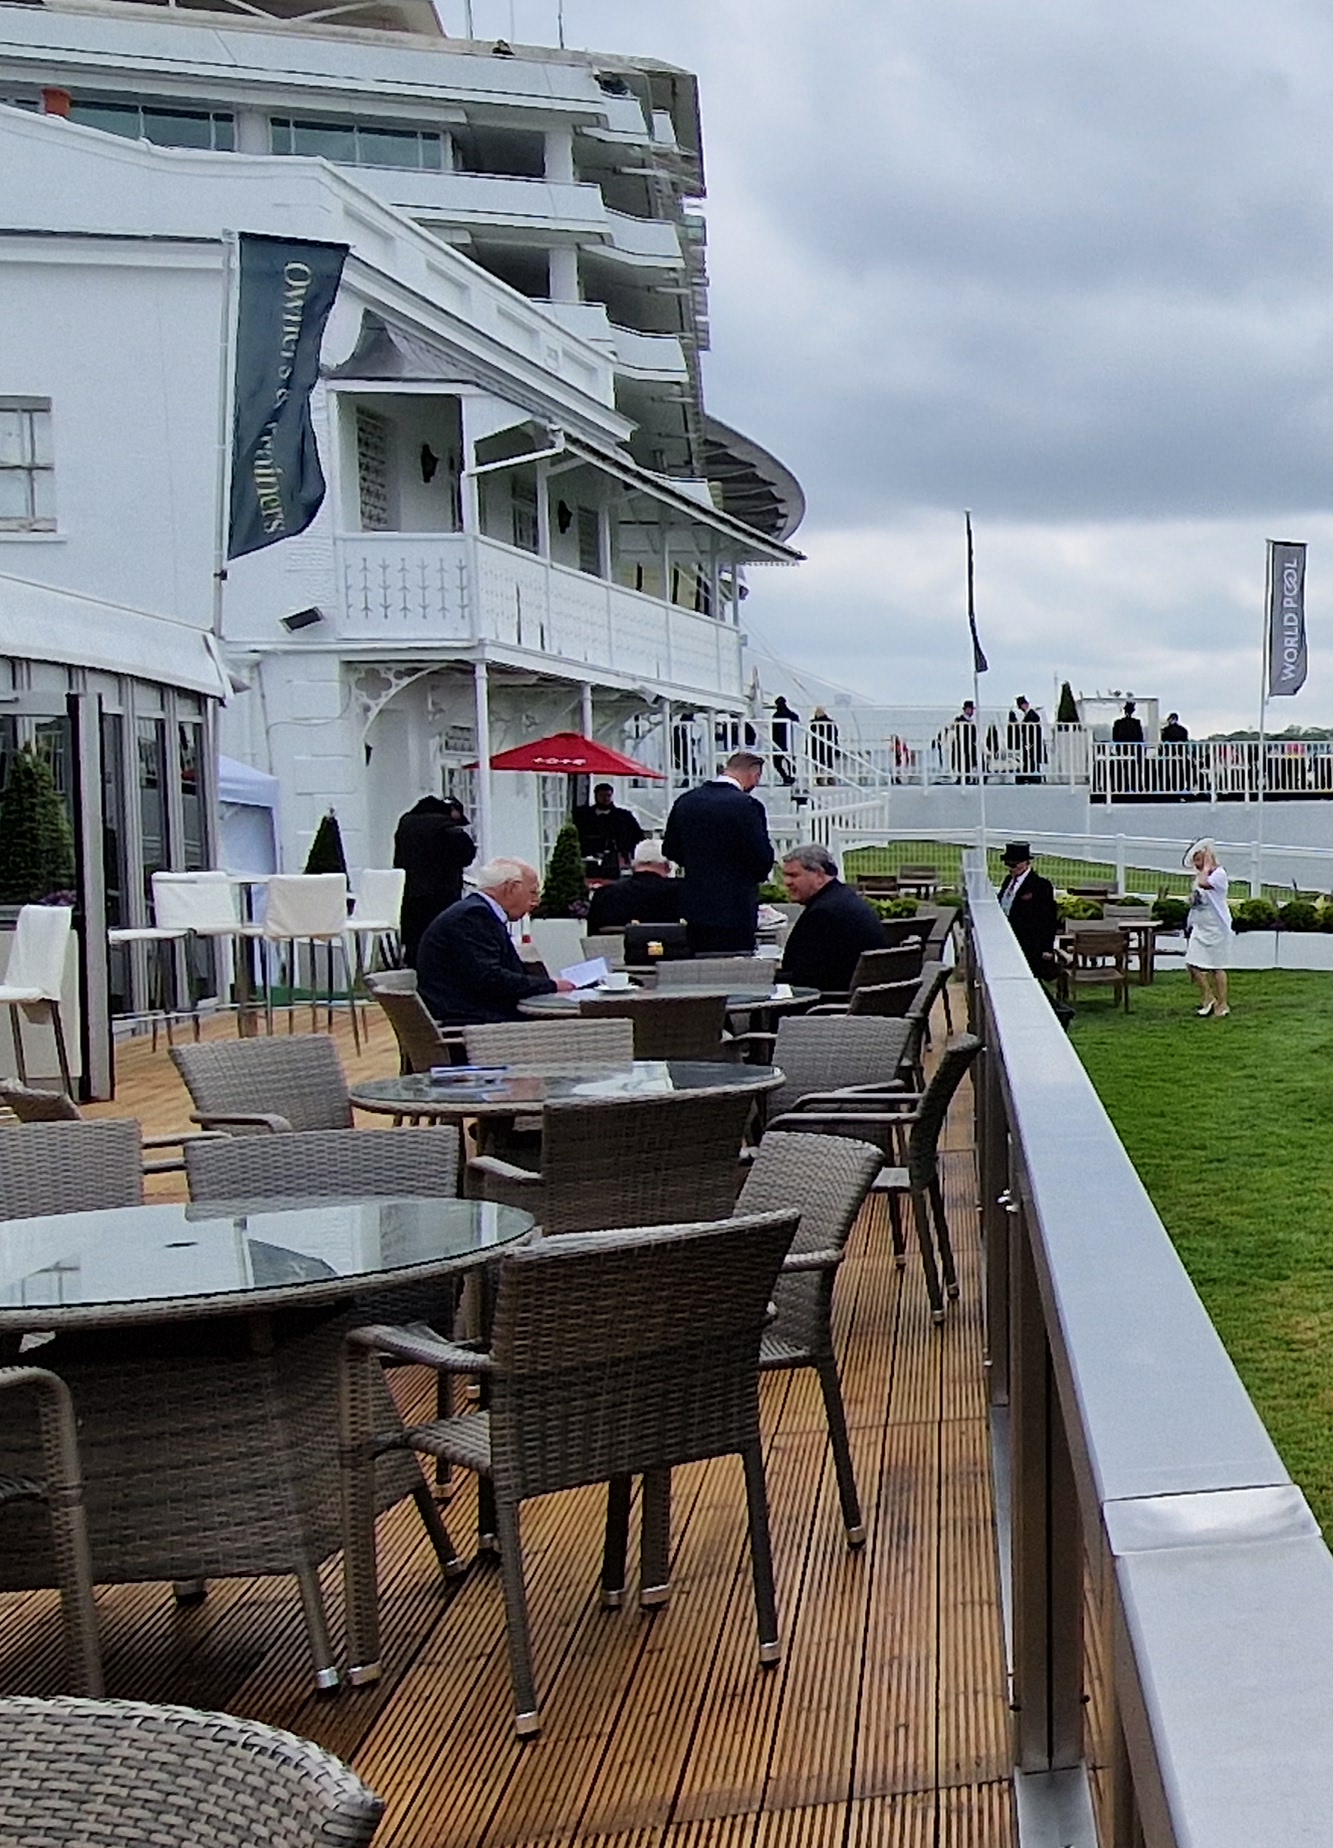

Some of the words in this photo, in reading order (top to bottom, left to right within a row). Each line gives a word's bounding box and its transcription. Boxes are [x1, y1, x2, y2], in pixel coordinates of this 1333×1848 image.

[252, 421, 286, 535] rainers
[1283, 557, 1299, 608] POOL
[1281, 614, 1299, 682] WORLD
